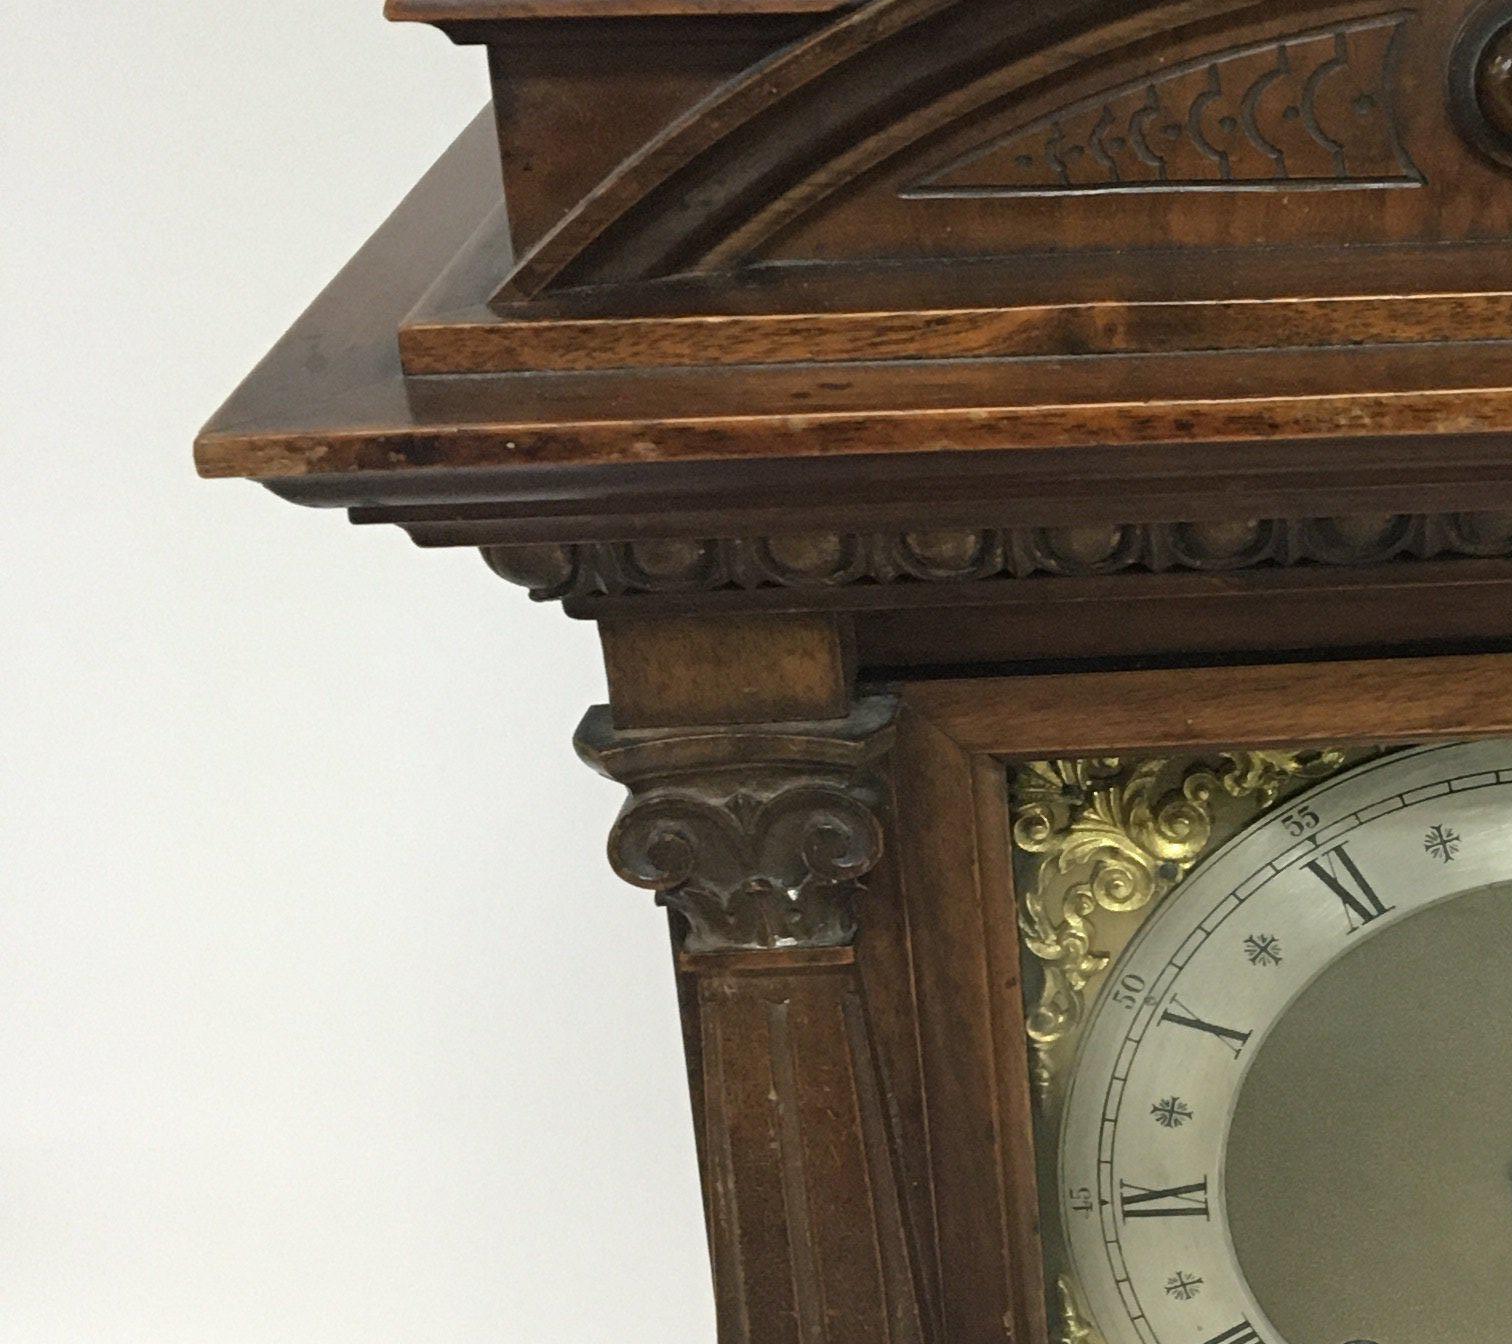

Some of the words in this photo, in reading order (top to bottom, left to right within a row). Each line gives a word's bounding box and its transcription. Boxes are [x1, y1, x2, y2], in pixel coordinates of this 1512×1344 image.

[1281, 805, 1321, 839] 55
[1300, 840, 1395, 935] XI
[1112, 973, 1146, 1011] 50
[1156, 993, 1254, 1060] X
[1119, 1175, 1210, 1224] IX
